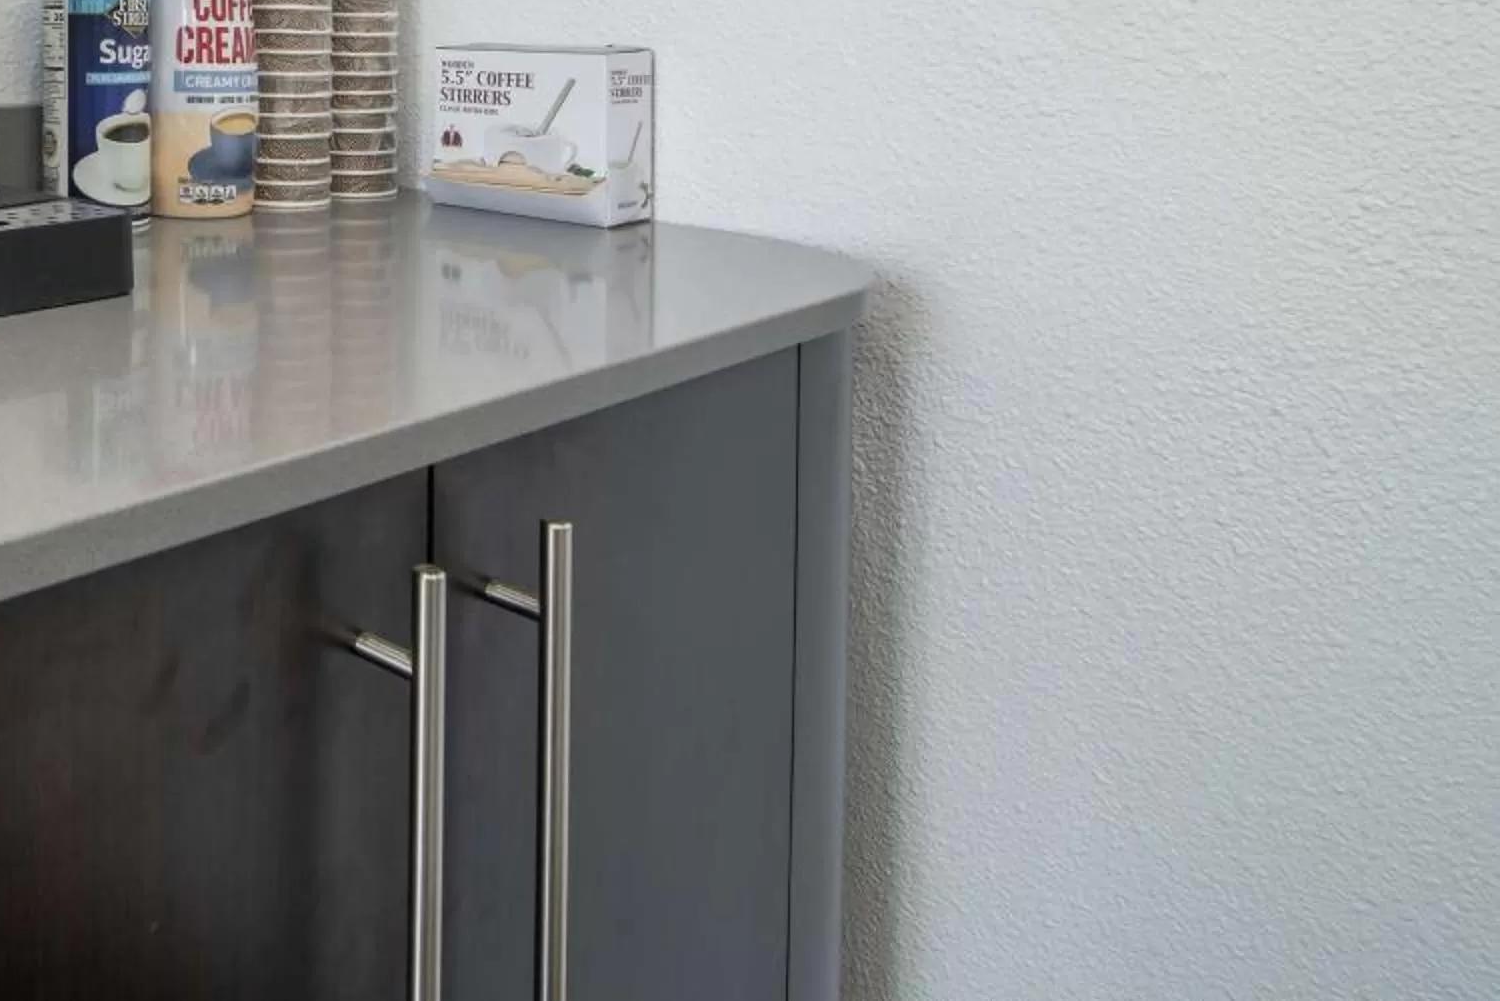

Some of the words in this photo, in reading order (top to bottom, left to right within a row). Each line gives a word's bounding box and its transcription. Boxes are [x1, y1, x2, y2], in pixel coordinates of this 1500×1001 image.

[99, 38, 149, 69] Suga
[476, 70, 535, 89] COFFEE
[440, 86, 512, 106] STIRRERS
